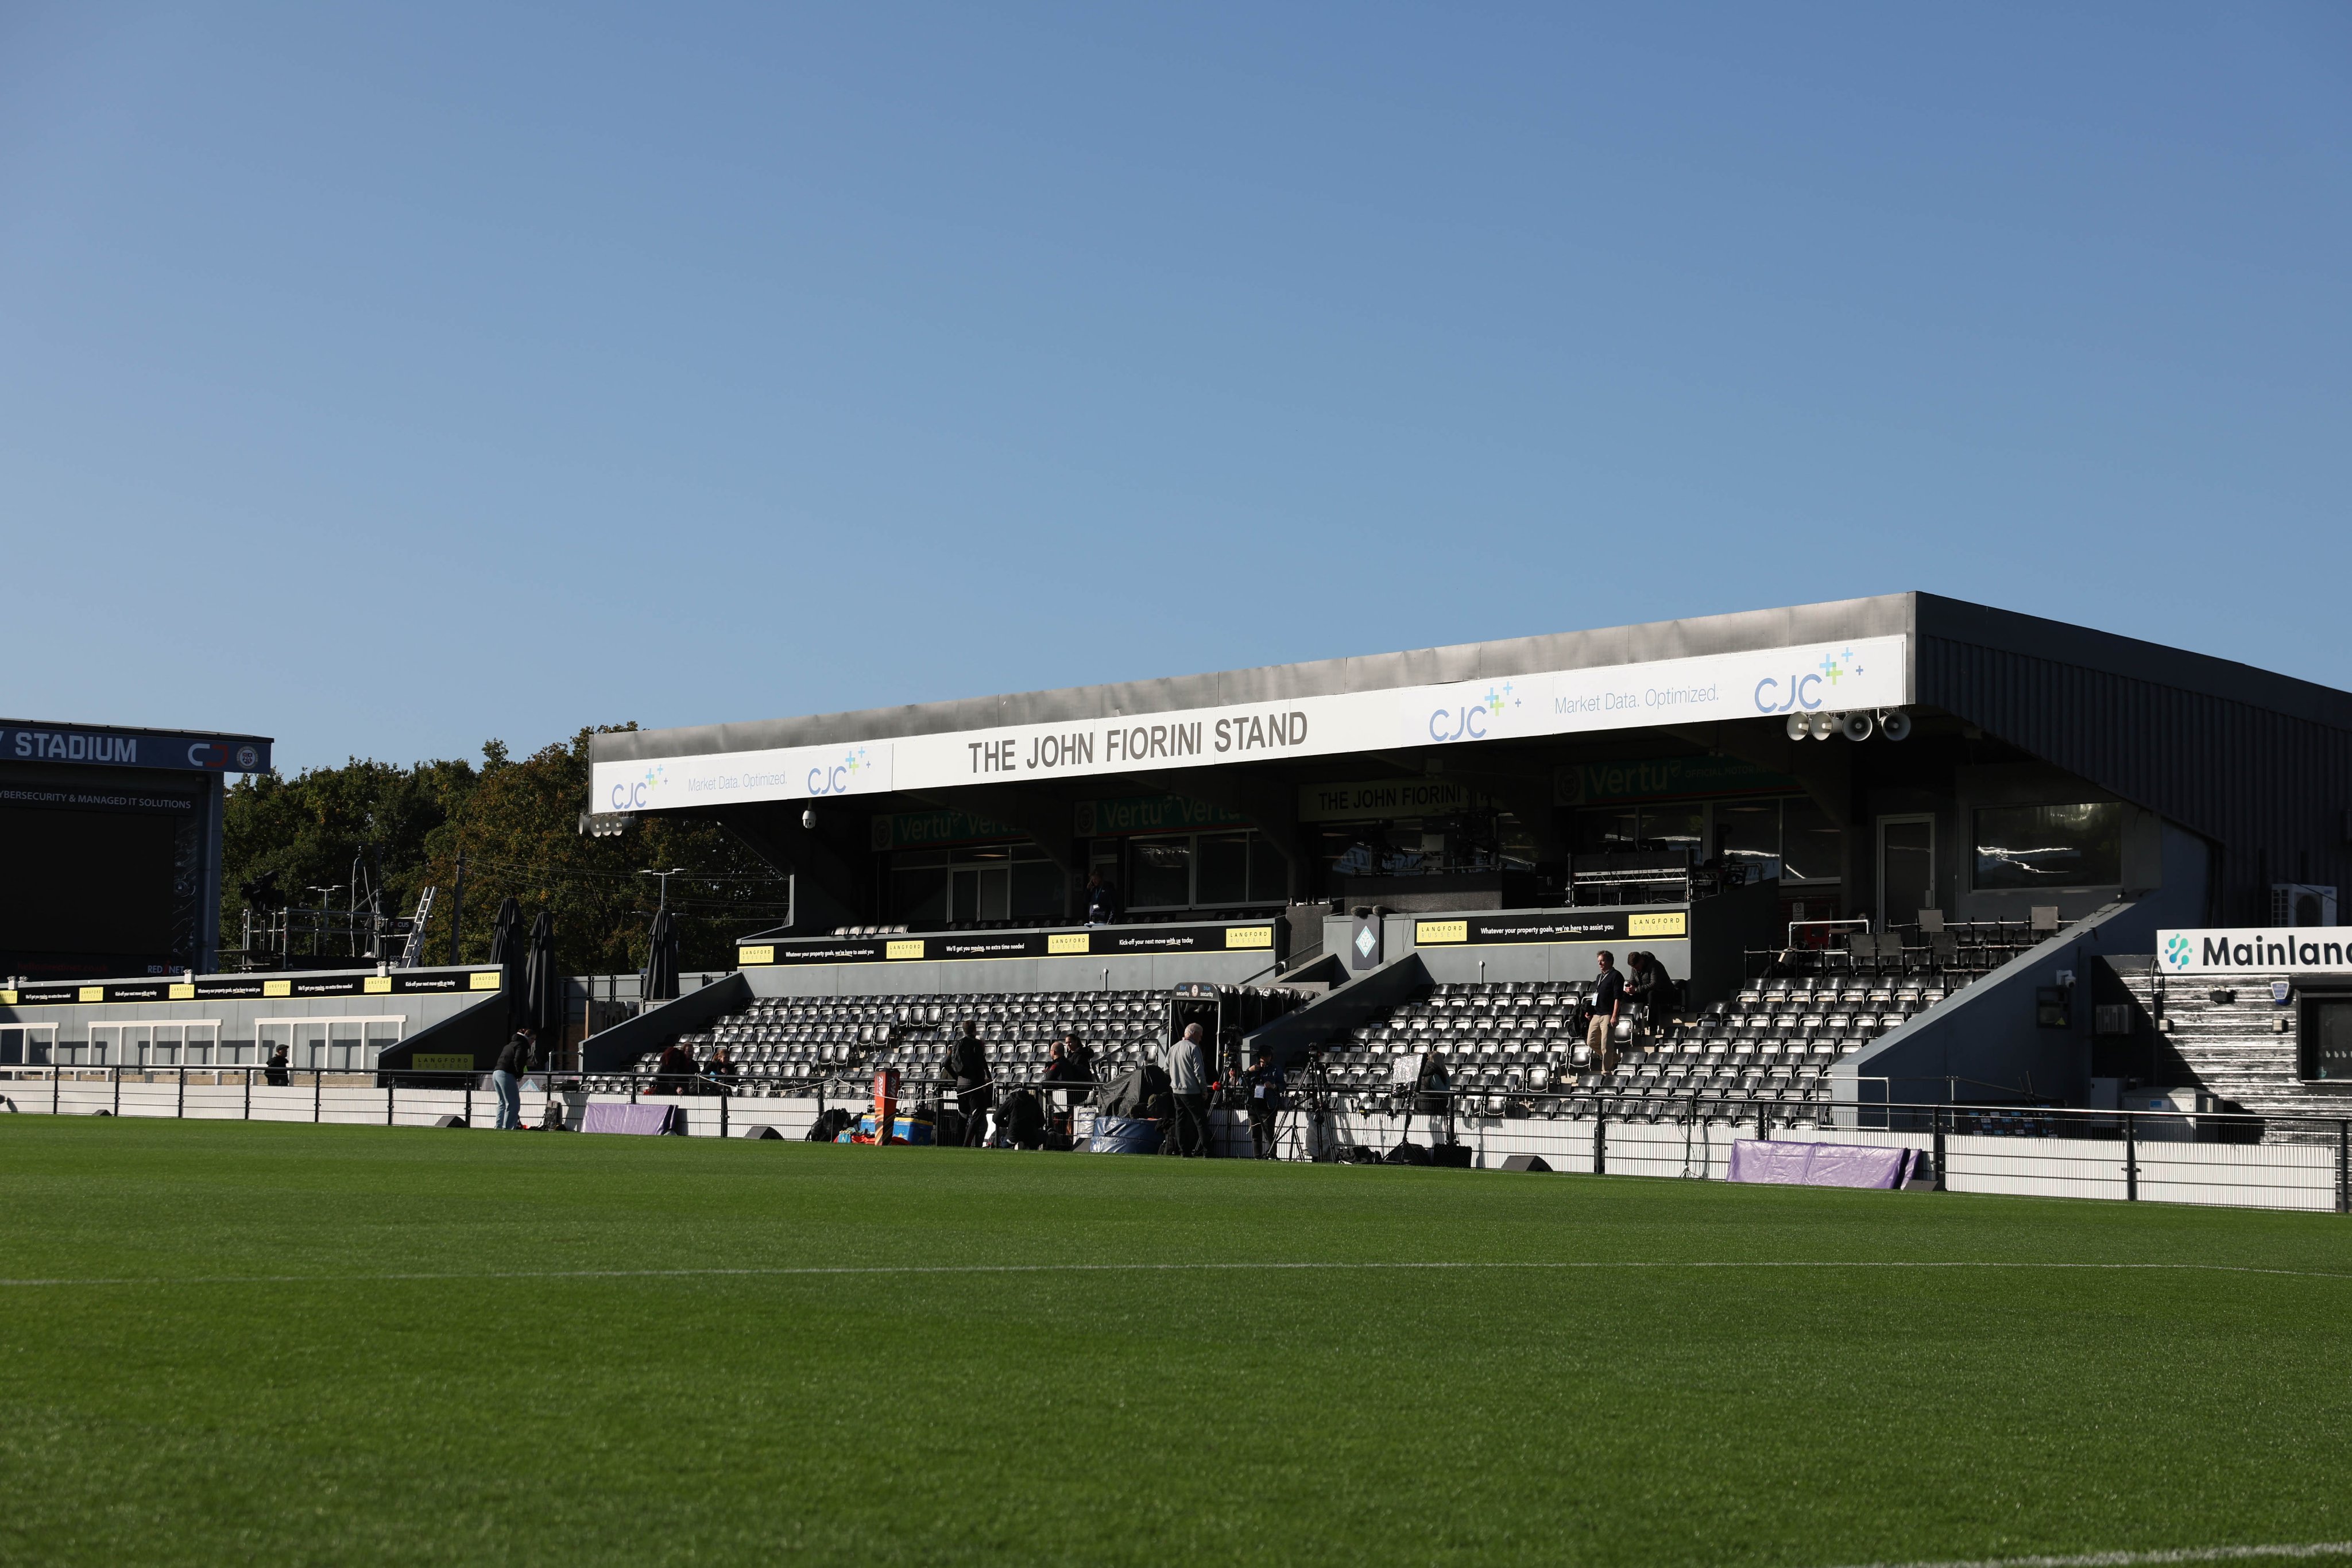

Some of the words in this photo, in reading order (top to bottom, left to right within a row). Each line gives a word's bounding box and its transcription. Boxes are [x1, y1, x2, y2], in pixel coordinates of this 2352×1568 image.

[1555, 694, 1600, 714] Market
[1606, 691, 1639, 710] Data.
[1645, 684, 1719, 708] Optimized.
[1754, 673, 1823, 714] CJC
[1429, 706, 1487, 742] CJC
[16, 732, 137, 763] STADIUM
[968, 740, 1016, 773] THE
[1027, 732, 1094, 769] JOHN
[1107, 722, 1202, 762] FIORINI
[1214, 711, 1307, 753] STAND
[688, 776, 716, 792] Market
[719, 775, 740, 789] Data.
[743, 771, 787, 790] Optimized.
[807, 766, 847, 796] CJC
[1589, 762, 1668, 796] Vertu
[1685, 767, 1723, 779] OFFICIAL
[69, 795, 76, 803] &
[78, 795, 126, 805] MANAGED
[139, 799, 191, 809] SOLUTIONS
[612, 782, 647, 810] CJC
[1318, 791, 1348, 811] THE
[1353, 788, 1397, 808] JOHN
[1402, 784, 1461, 806] FIORINI
[900, 815, 951, 841] Vertu
[1103, 799, 1162, 828] Vertu
[1517, 927, 1538, 935] property
[1539, 926, 1554, 934] goals,
[2203, 935, 2352, 966] Mainlan
